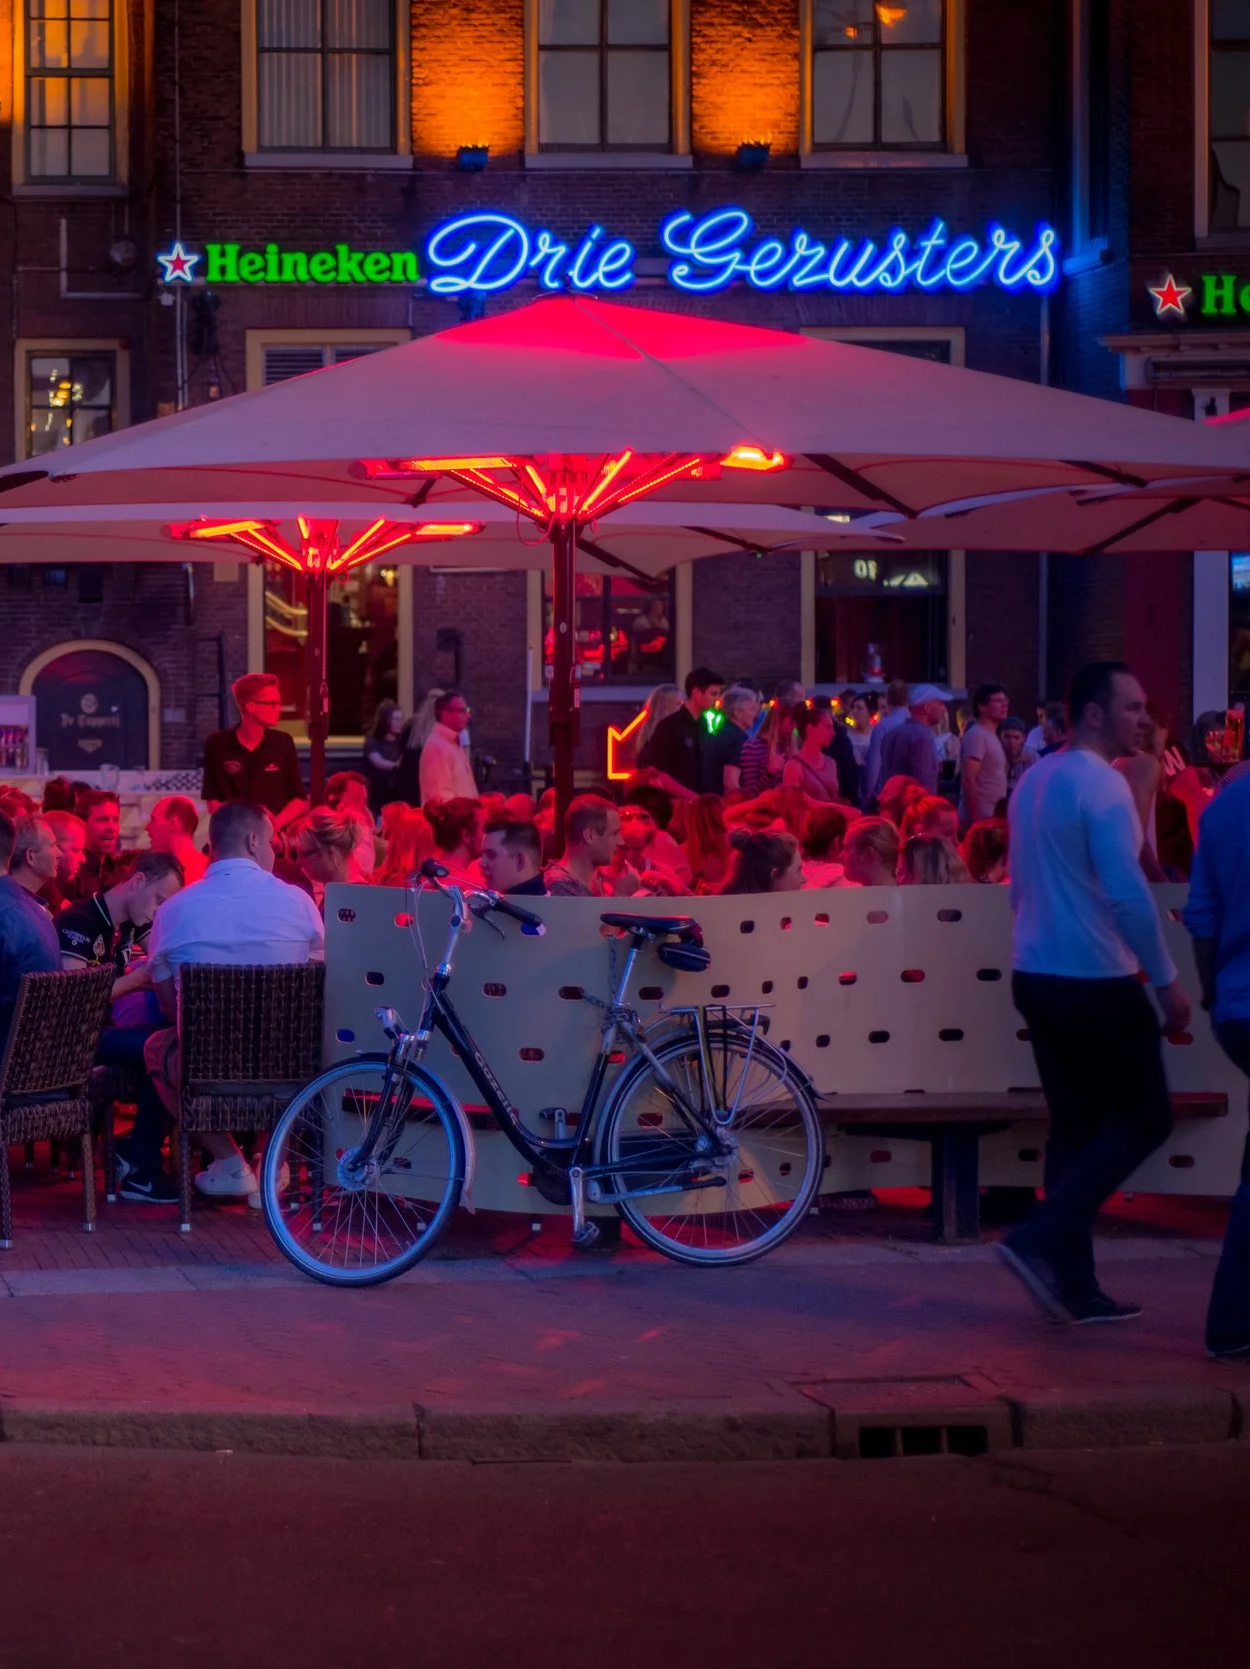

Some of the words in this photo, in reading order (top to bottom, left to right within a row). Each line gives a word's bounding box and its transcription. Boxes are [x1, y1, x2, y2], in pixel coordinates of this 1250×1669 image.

[205, 243, 420, 282] Heineken
[426, 213, 634, 293] Drie
[660, 208, 1057, 292] Gezusters
